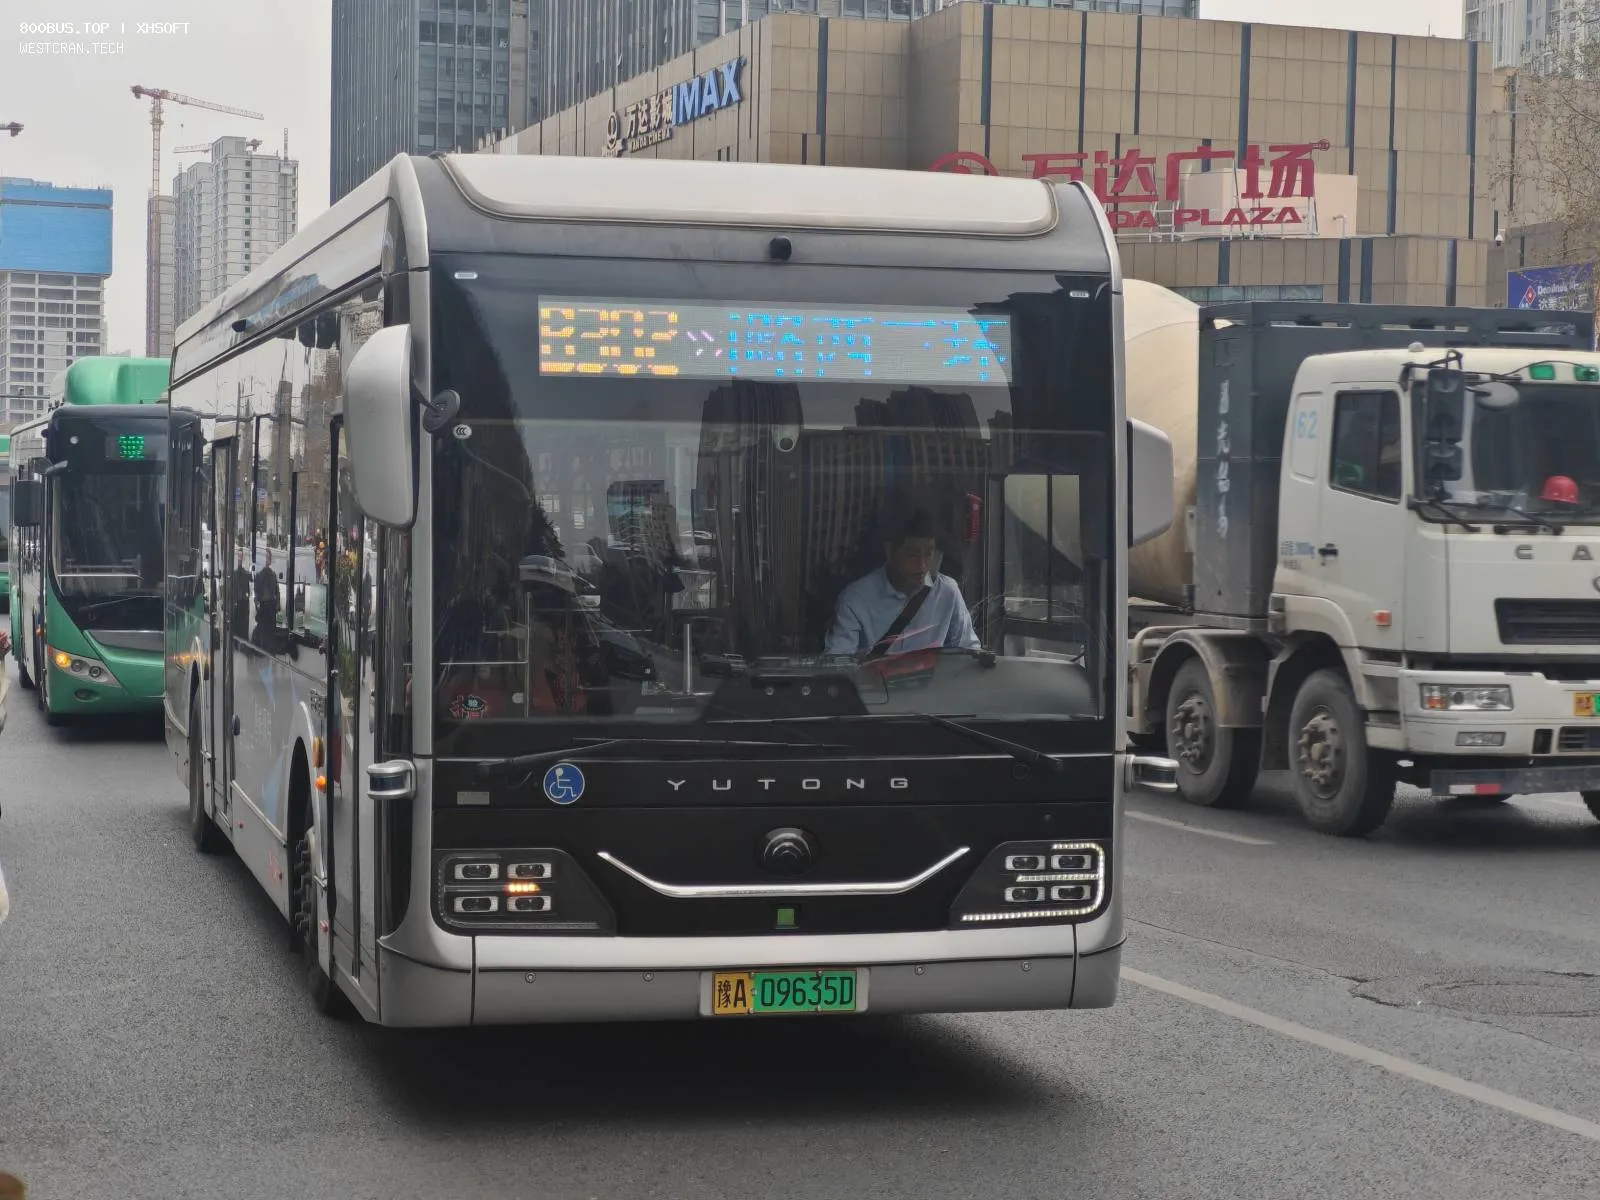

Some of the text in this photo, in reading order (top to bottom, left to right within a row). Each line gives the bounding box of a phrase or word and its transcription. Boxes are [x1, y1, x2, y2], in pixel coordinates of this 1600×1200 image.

[672, 57, 742, 126] IMAX
[1174, 206, 1303, 226] PLAZA
[667, 777, 909, 791] YUTONG
[760, 976, 854, 1007] 09635D
